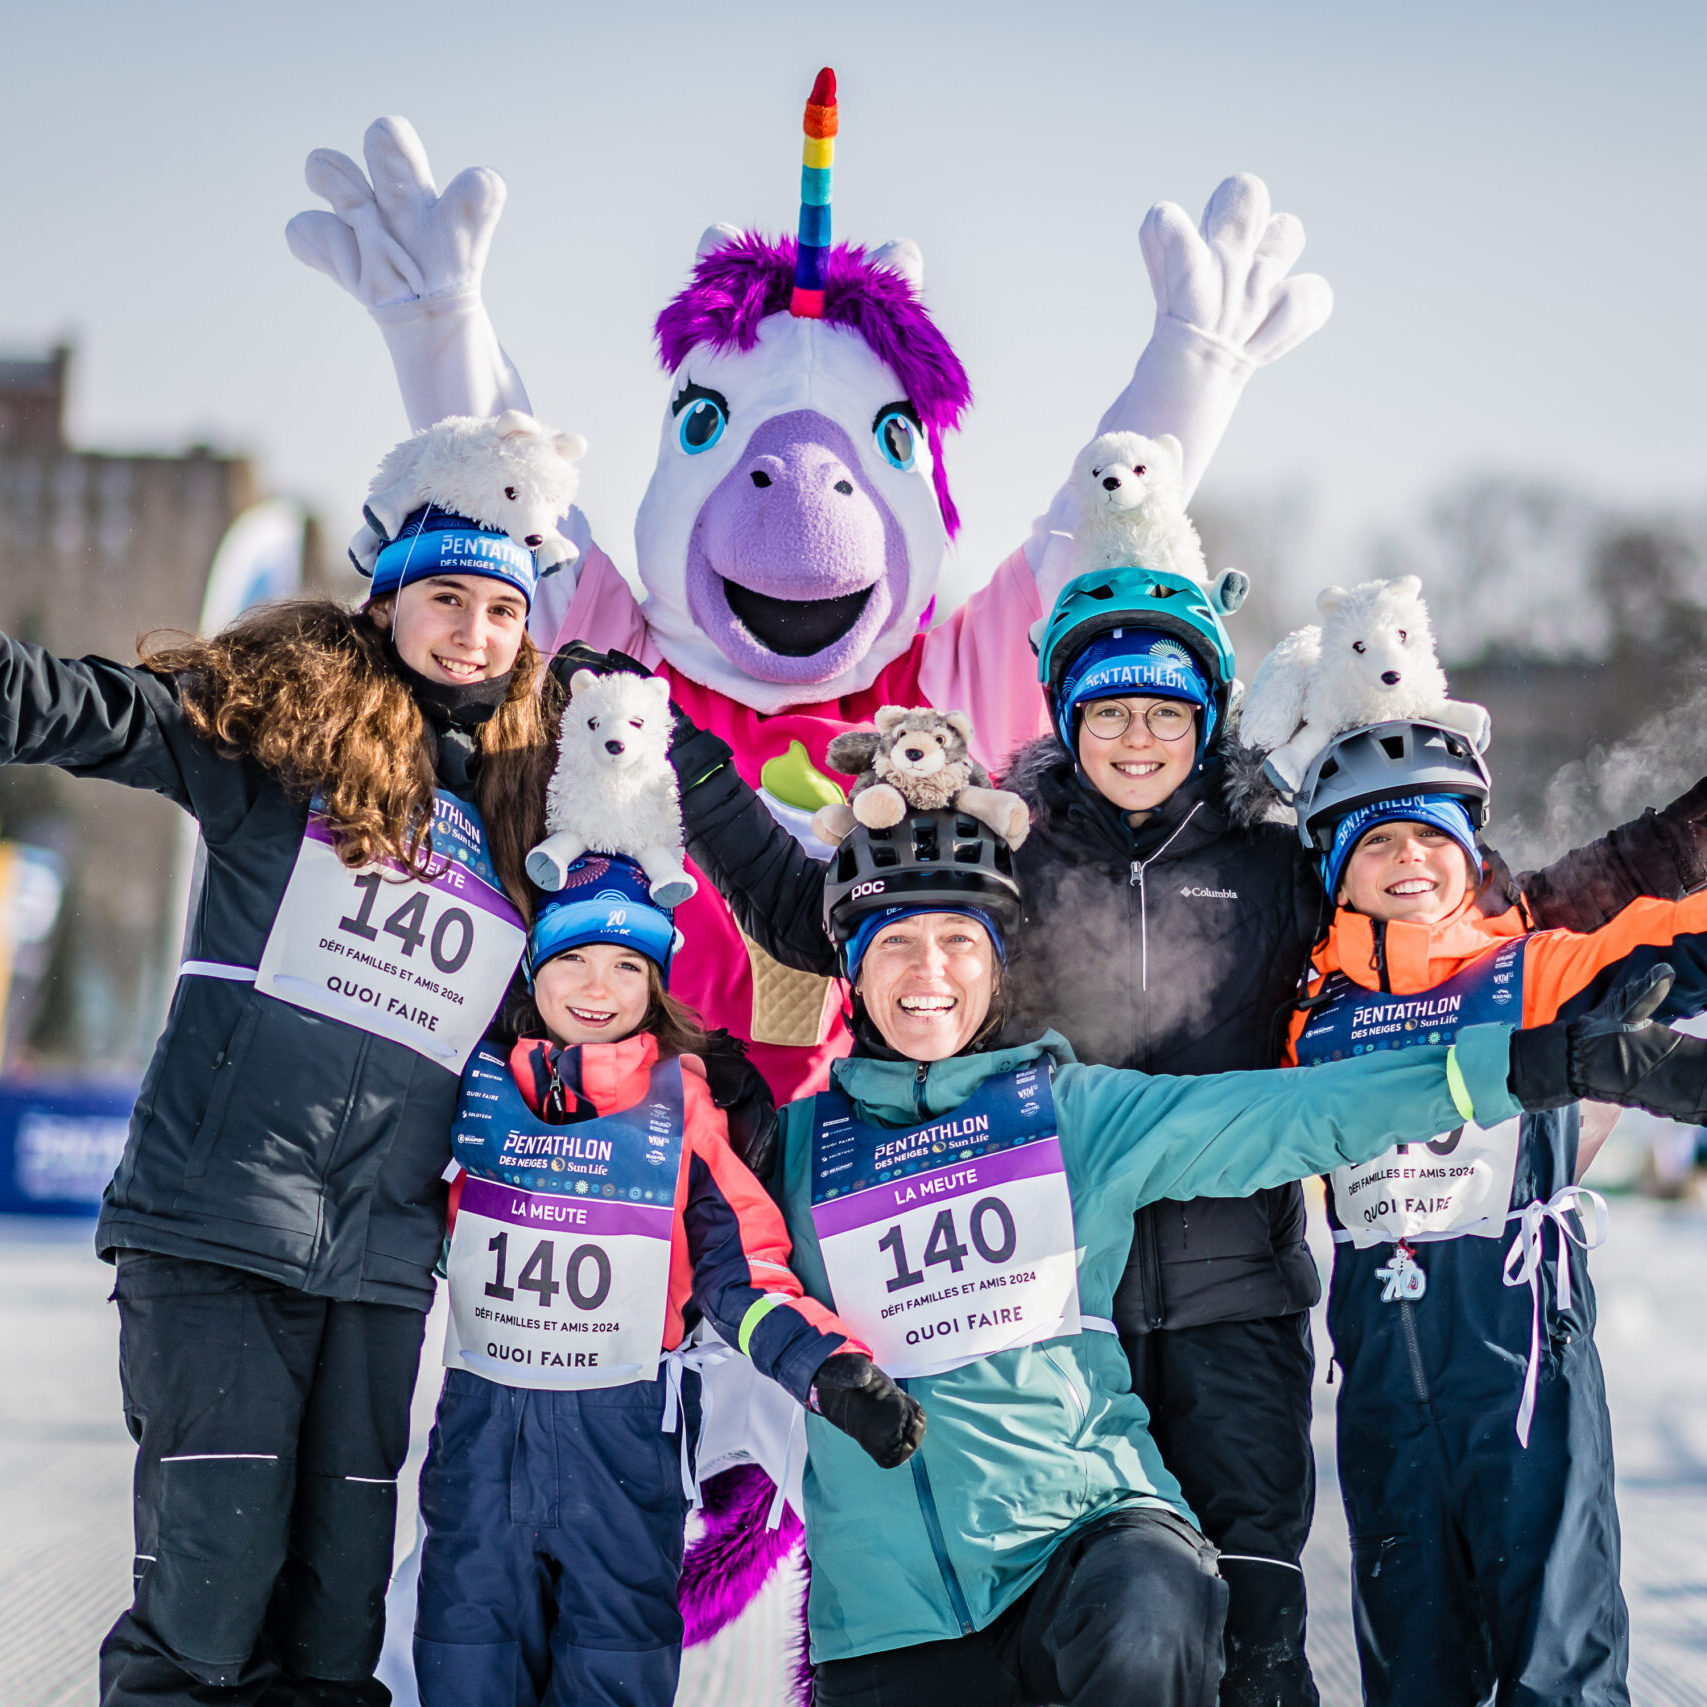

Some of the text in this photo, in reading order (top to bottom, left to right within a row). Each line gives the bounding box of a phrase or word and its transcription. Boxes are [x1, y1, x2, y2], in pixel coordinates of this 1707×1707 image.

[440, 559, 495, 571] DES NEIGES
[433, 797, 481, 845] ATHLON
[452, 829, 468, 844] Sun
[1191, 887, 1239, 899] Columbia
[338, 872, 474, 974] 140
[606, 909, 626, 927] 20
[319, 938, 464, 1006] DÉFI FAMILLES ET AMIS 2024
[327, 976, 439, 1032] QUOI FAIRE
[1352, 994, 1462, 1028] PENTATHLON
[1351, 1023, 1402, 1040] DES NEIGES
[1420, 1014, 1458, 1028] Sun Life
[503, 1129, 612, 1161] PENTATHLON
[874, 1114, 989, 1160] PENTATHLON
[948, 1133, 989, 1149] Sun Life
[499, 1155, 548, 1169] DES NEIGES
[567, 1162, 608, 1176] Sun Life
[875, 1147, 929, 1170] DES NEIGES
[894, 1168, 978, 1205] LA MEUTE
[1348, 1167, 1475, 1196] DÉFI FAMILLES ET AMIS 2024
[511, 1199, 588, 1225] LA MEUTE
[1364, 1197, 1452, 1223] QUOI FAIRE
[878, 1196, 1017, 1293] 140
[484, 1231, 612, 1311] 140
[881, 1271, 1036, 1319] DÉFI FAMILLES ET AMIS 2024
[475, 1307, 620, 1333] DÉFI FAMILLES ET AMIS 2024
[905, 1306, 1023, 1345] QUOI FAIRE
[487, 1342, 599, 1368] QUOI FAIRE
